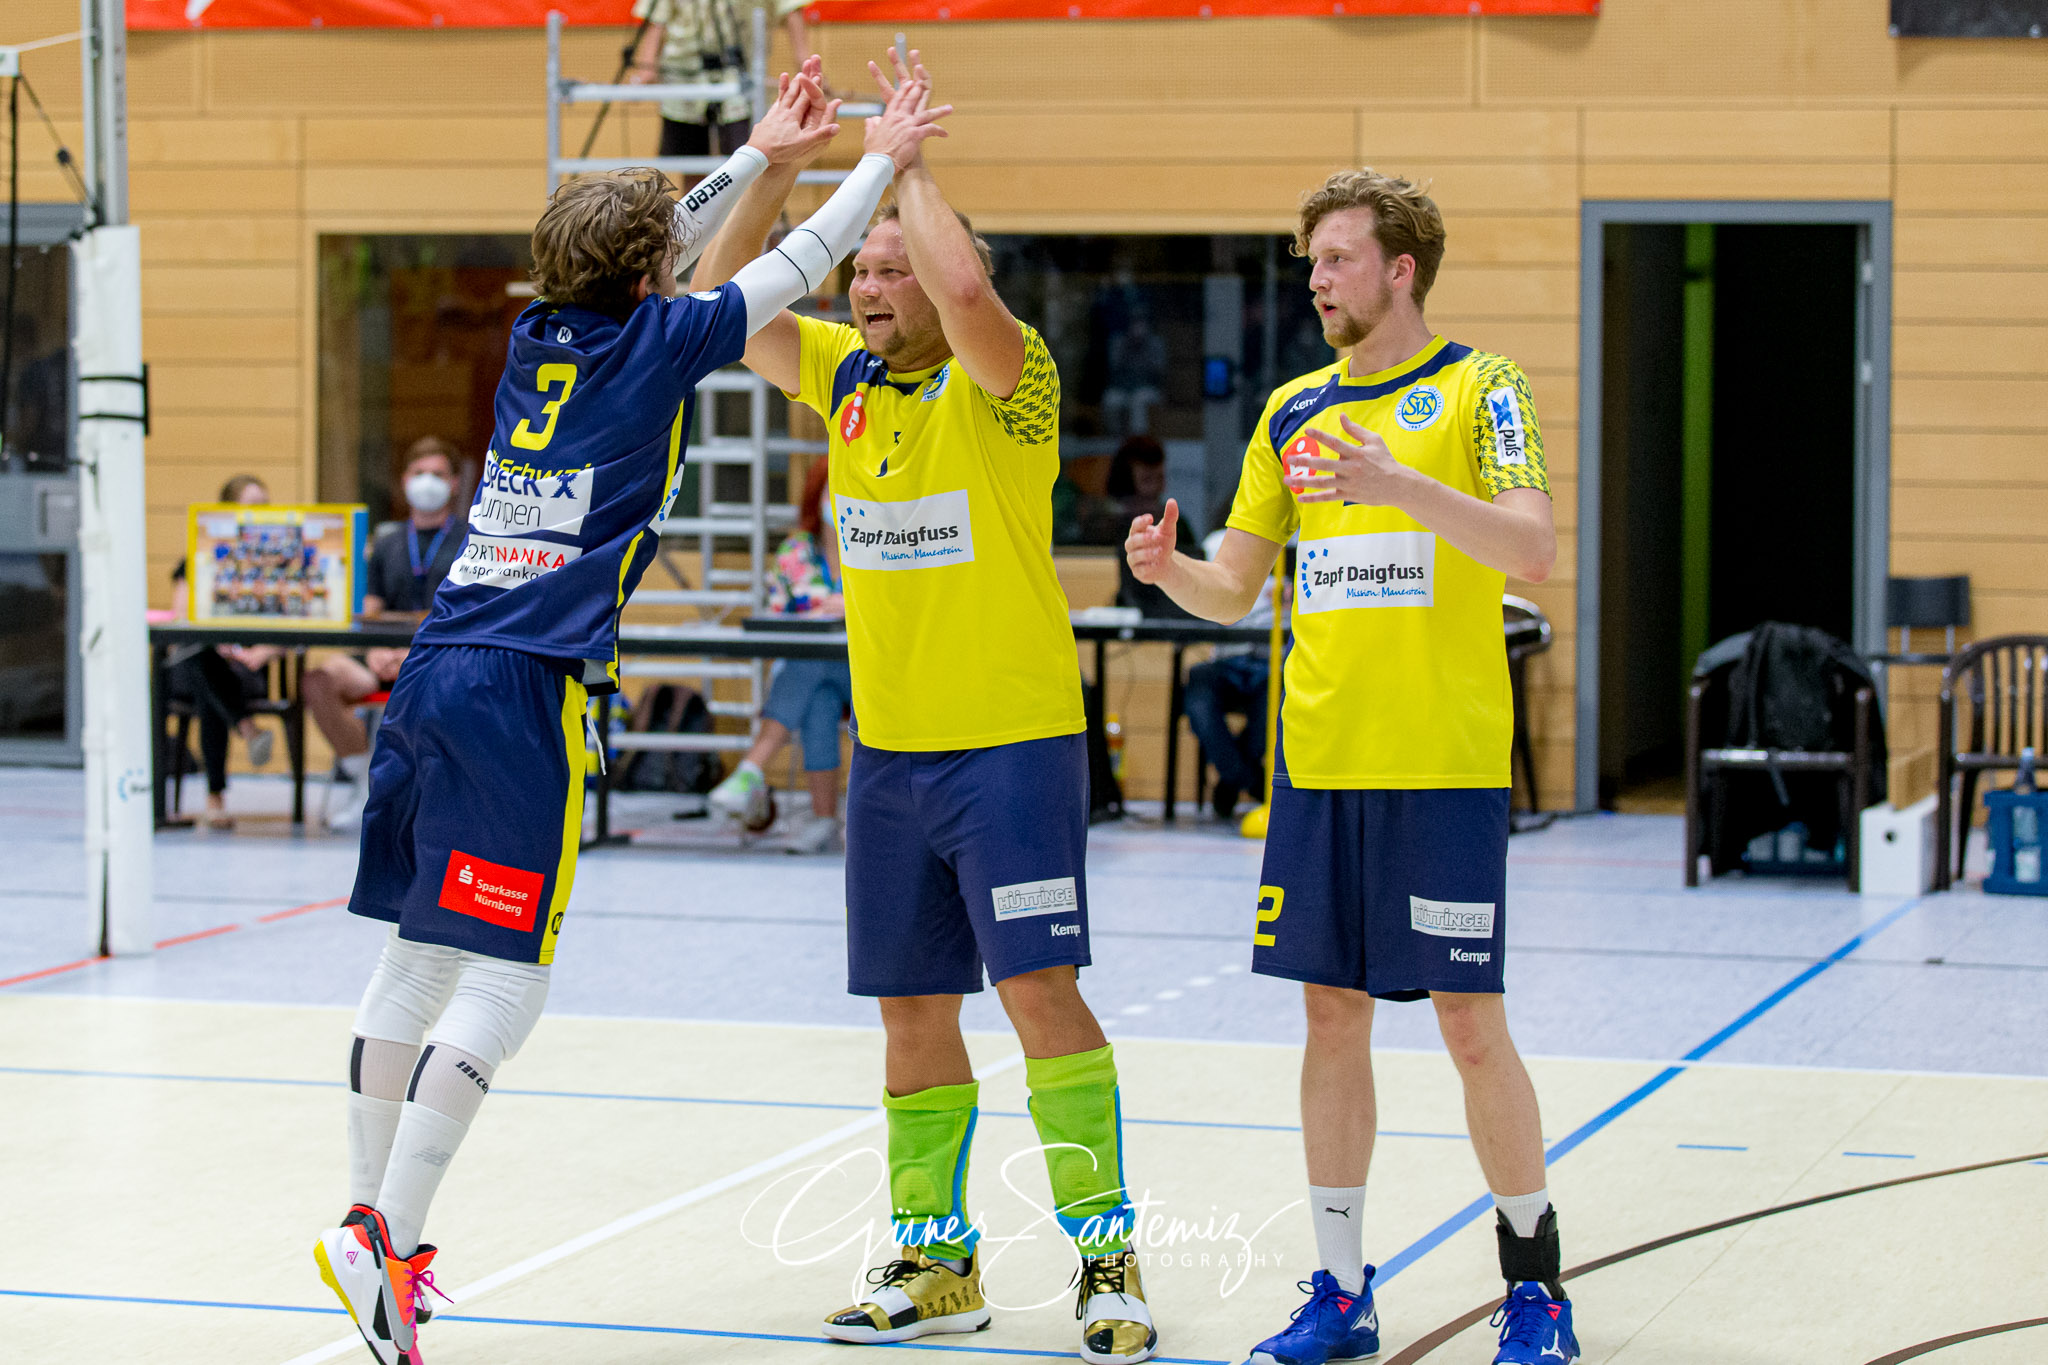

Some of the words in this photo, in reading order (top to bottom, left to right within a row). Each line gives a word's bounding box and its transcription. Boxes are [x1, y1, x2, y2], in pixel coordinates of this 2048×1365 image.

[685, 183, 718, 213] cep
[510, 363, 578, 452] 3
[1498, 429, 1522, 457] puls
[850, 527, 883, 548] Zapf
[883, 525, 960, 547] Daigfuss
[1314, 566, 1344, 588] Zapf
[1347, 563, 1424, 584] Daigfuss
[476, 878, 529, 901] Sparkasse
[474, 892, 523, 917] Nürnberg
[1253, 884, 1285, 947] 2
